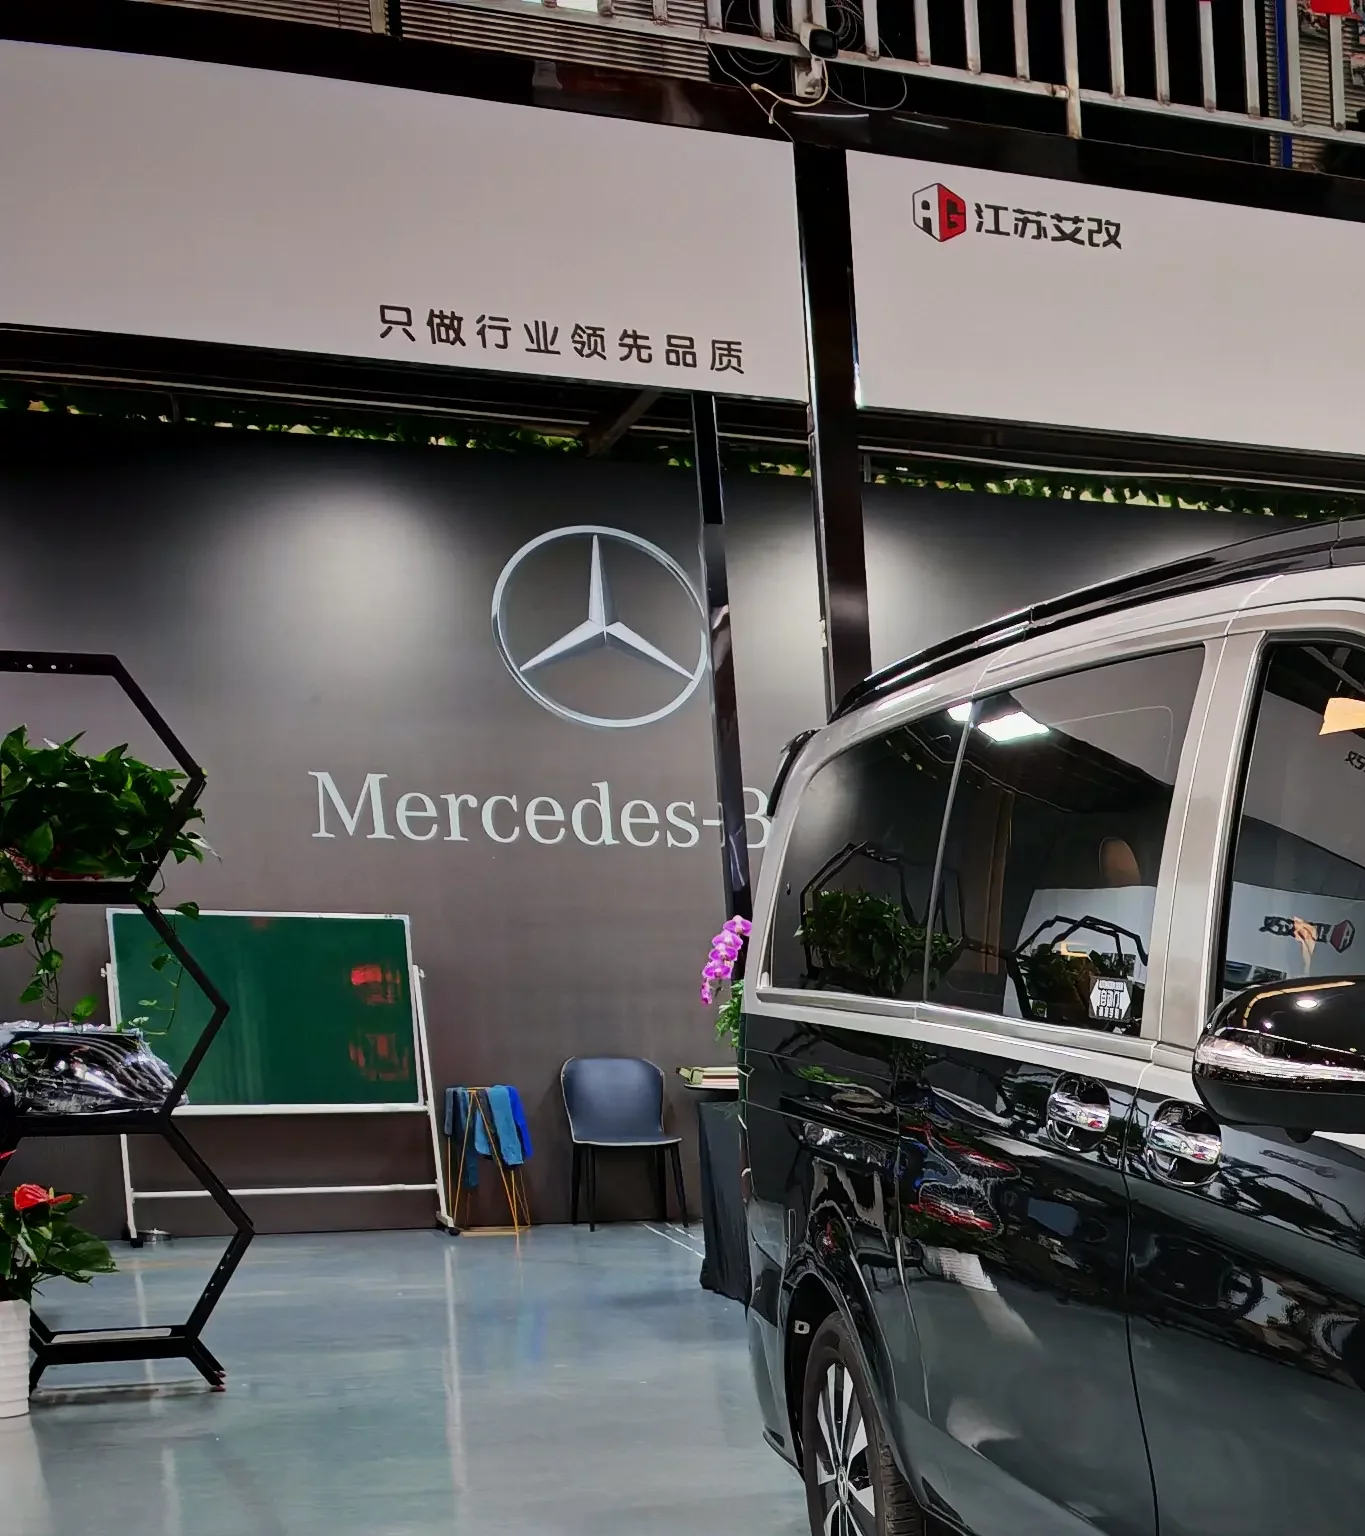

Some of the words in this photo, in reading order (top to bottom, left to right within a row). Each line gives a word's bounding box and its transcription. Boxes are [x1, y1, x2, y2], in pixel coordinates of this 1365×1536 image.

[974, 202, 1122, 250] 江苏艾改
[379, 303, 745, 375] 只做行业领先品质
